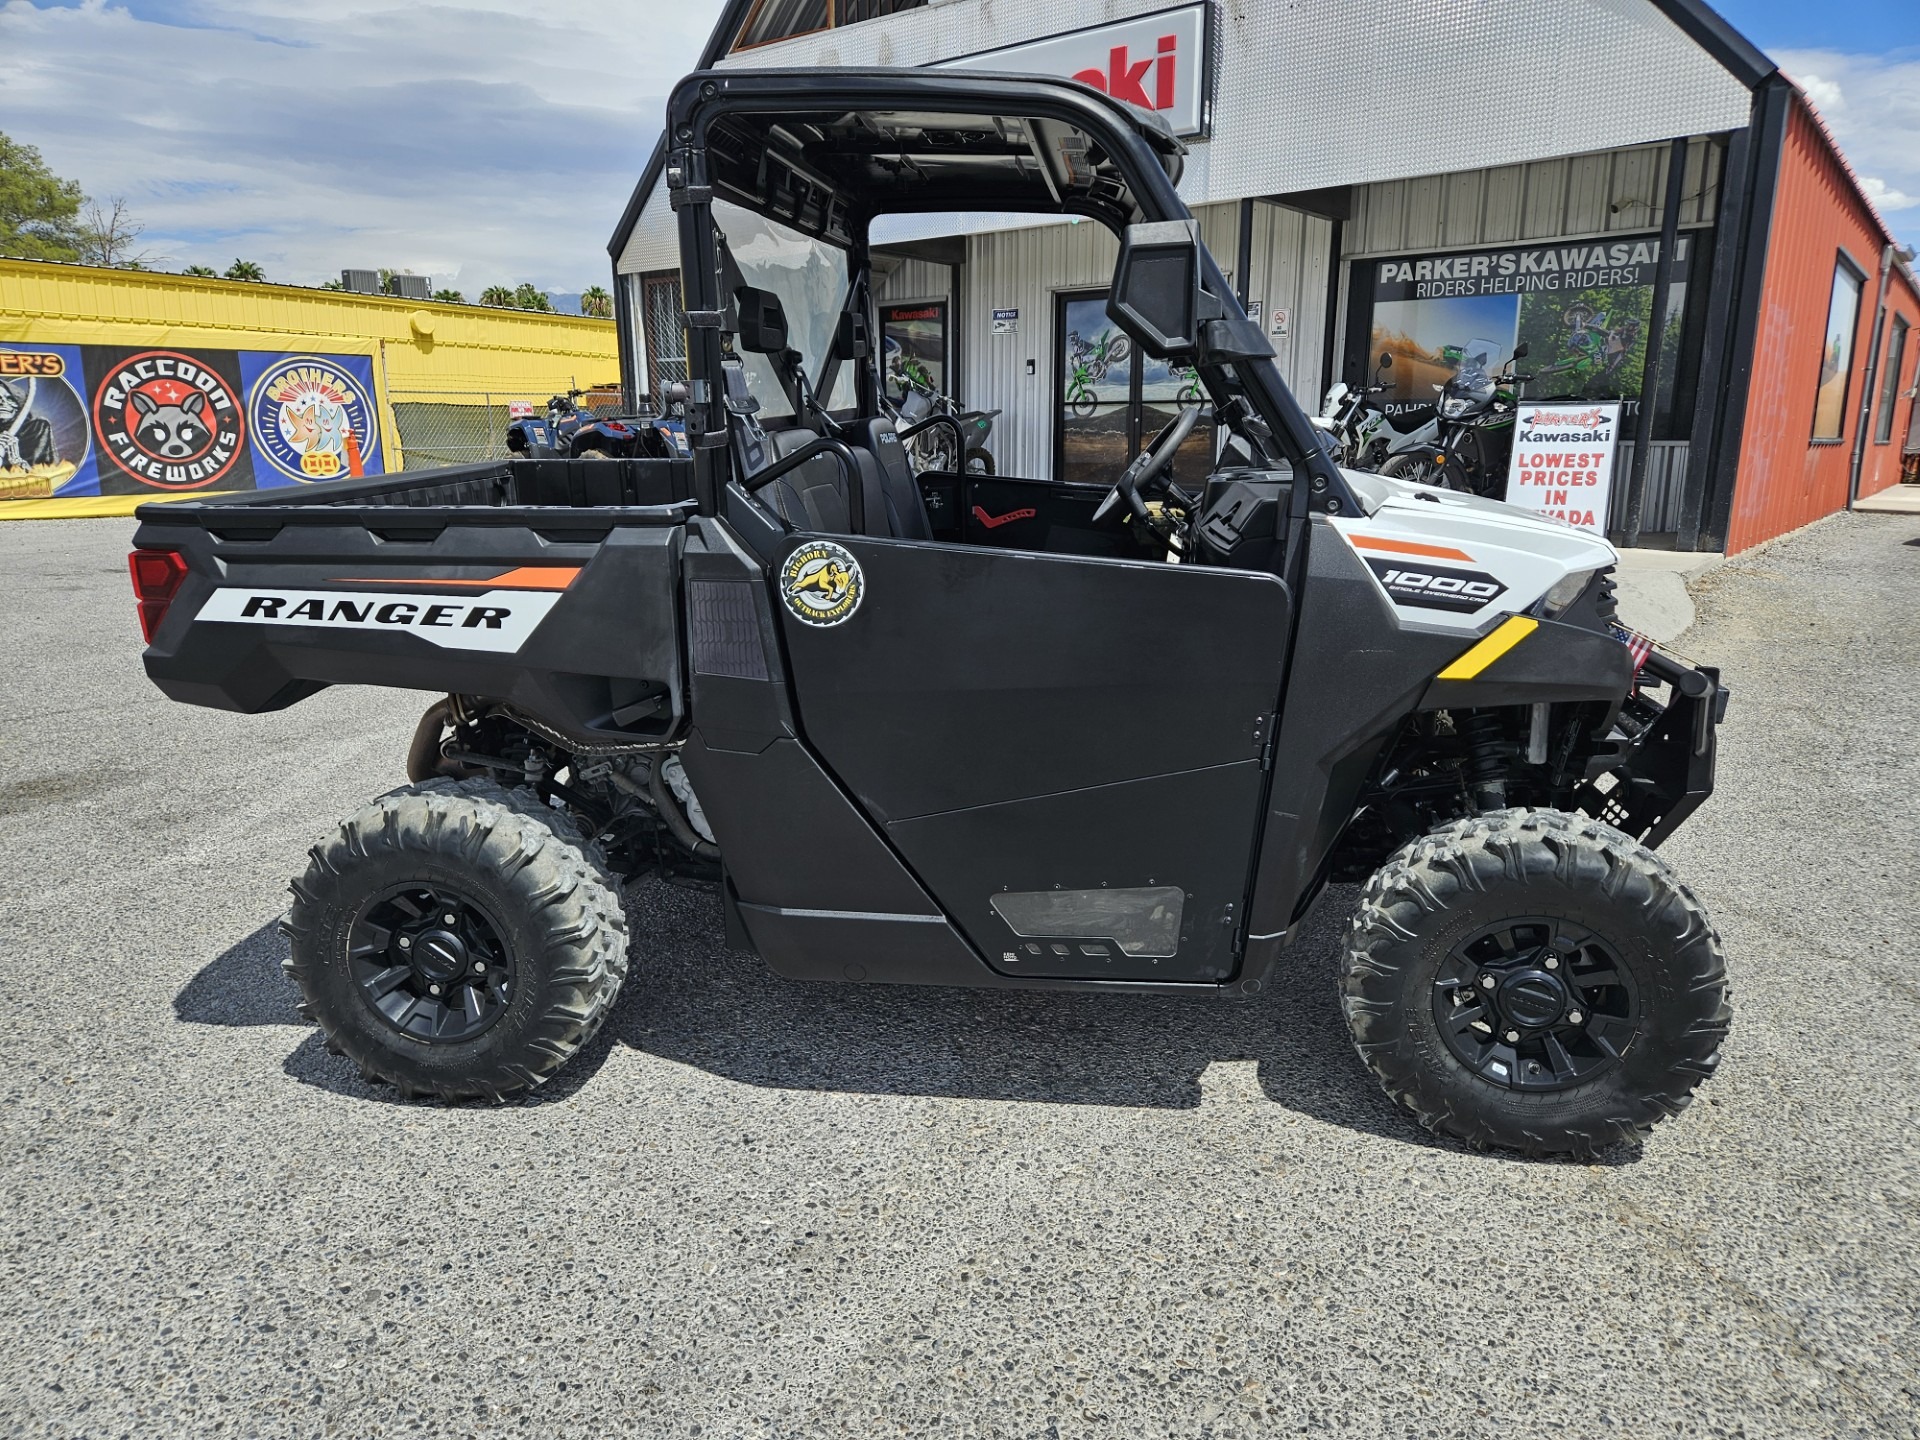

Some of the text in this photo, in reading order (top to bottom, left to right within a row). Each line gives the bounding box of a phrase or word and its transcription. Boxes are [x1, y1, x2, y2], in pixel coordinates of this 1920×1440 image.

[1380, 239, 1686, 284] PARKER'S KAWASAI
[1416, 267, 1640, 298] RIDERS HELPING RIDERS!
[891, 307, 939, 321] Kawasaki
[104, 359, 231, 411] RACCOON
[266, 367, 357, 404] BROTHERS
[1519, 430, 1611, 442] Kawasaki
[108, 430, 237, 484] FIREWORKS
[1518, 453, 1605, 468] LOWEST
[1519, 471, 1598, 486] PRICES
[1544, 490, 1568, 506] IN
[1382, 569, 1499, 596] 1000
[240, 596, 512, 630] RANGER
